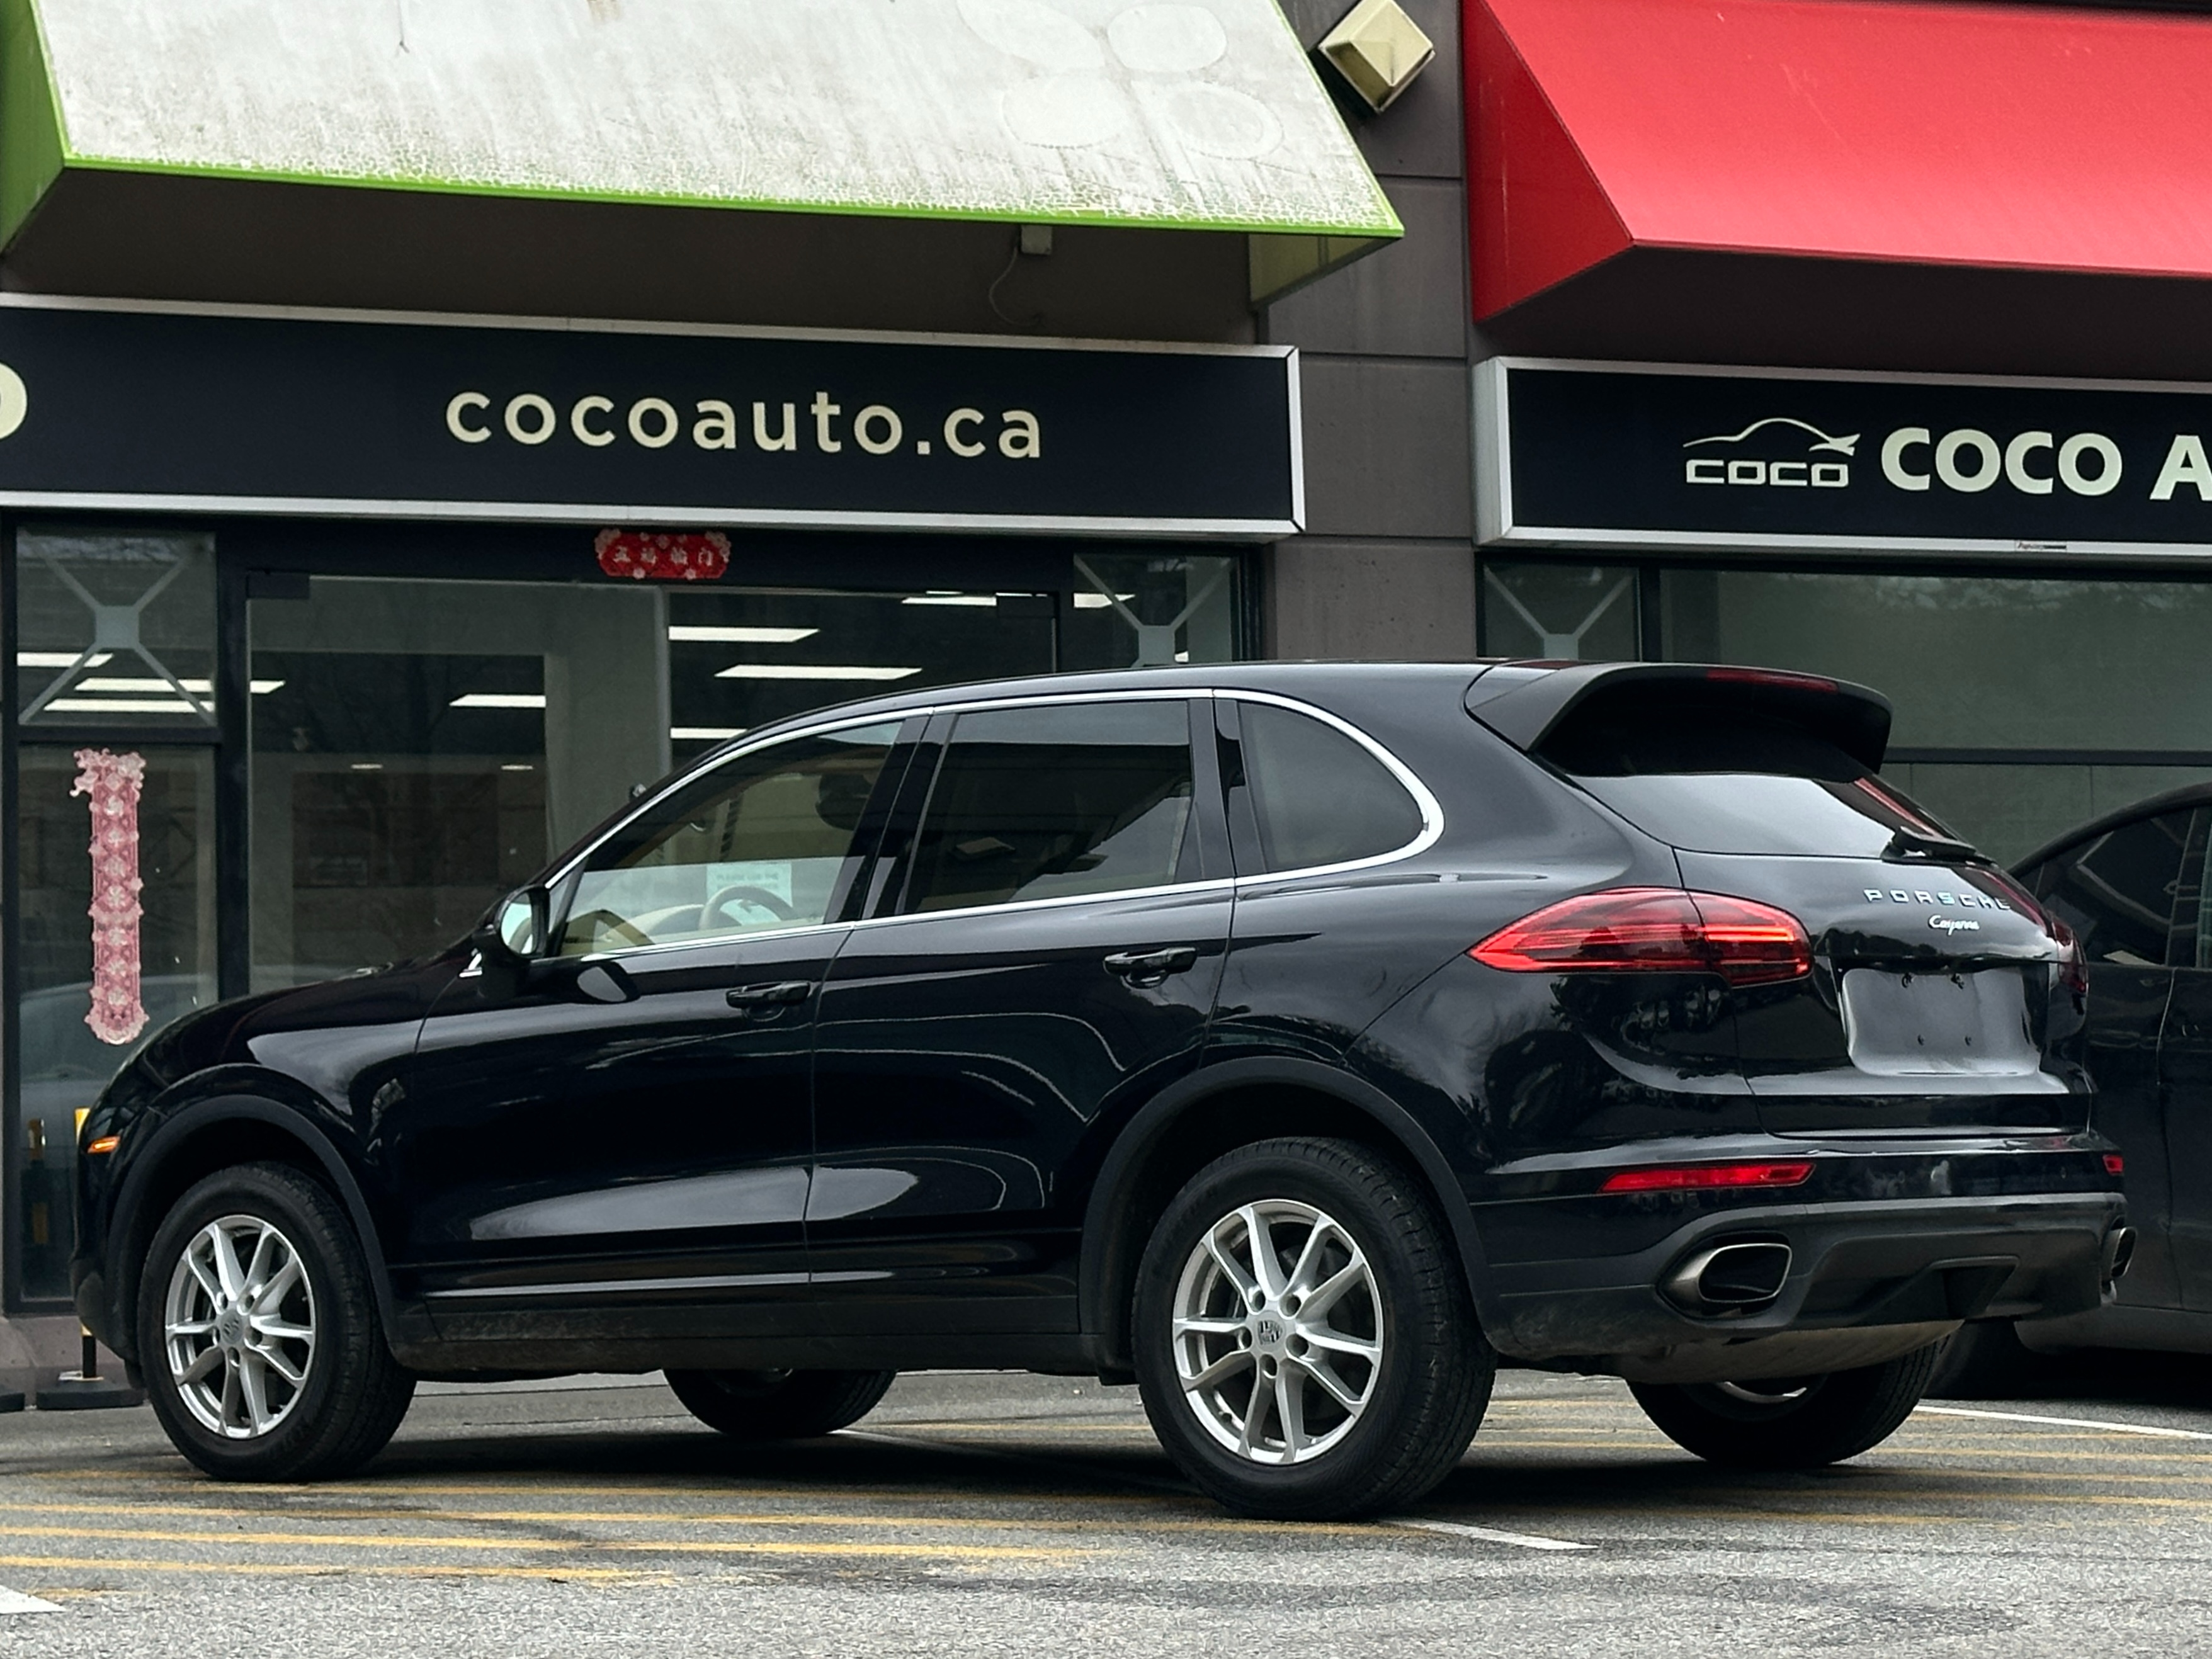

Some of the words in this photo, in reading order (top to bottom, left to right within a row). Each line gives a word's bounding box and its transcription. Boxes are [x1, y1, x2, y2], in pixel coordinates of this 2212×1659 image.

[446, 392, 1041, 459] cocoauto.ca
[1686, 459, 1849, 488] COCO
[1881, 427, 2123, 497] COCO
[1863, 888, 2011, 910] PORSCHE
[1927, 914, 1980, 936] Cayenne
